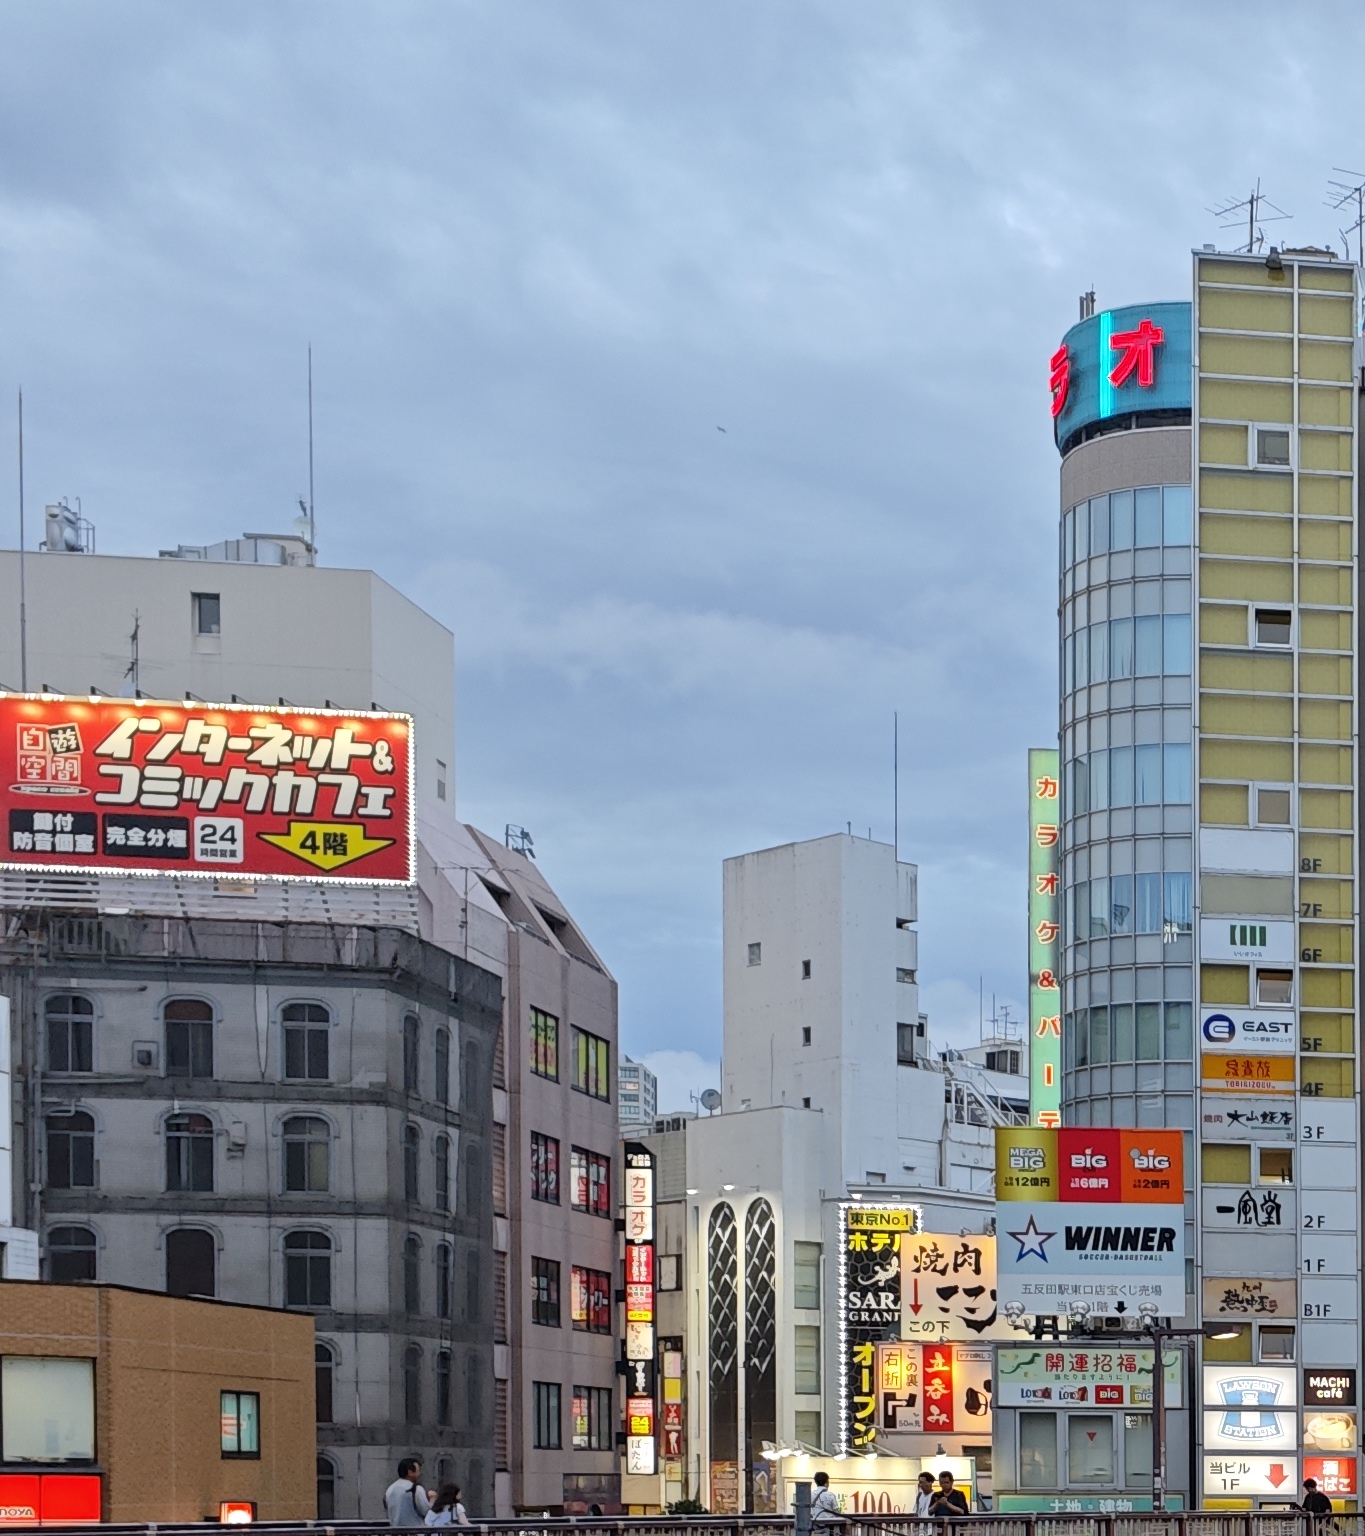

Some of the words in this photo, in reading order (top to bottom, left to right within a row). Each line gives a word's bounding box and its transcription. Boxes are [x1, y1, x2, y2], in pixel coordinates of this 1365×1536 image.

[95, 718, 394, 773] インターネット&
[95, 764, 394, 817] コミックカフェ
[200, 824, 237, 844] 24
[299, 830, 348, 856] 4階
[1301, 857, 1322, 873] 8F
[1301, 903, 1322, 918] 7F
[1301, 948, 1323, 963] 6F
[1242, 1021, 1294, 1034] EAST
[1302, 1037, 1323, 1051] 5F
[1302, 1082, 1325, 1097] 4F
[1302, 1125, 1326, 1140] 3F
[1010, 1148, 1045, 1156] MEGA
[1010, 1157, 1045, 1170] BIG
[1070, 1154, 1108, 1169] BIG
[1134, 1154, 1171, 1170] BIG
[631, 1175, 646, 1237] カラオケ
[1215, 1189, 1282, 1227] 一風堂
[850, 1213, 910, 1227] 東京No.1
[1303, 1215, 1327, 1229] 2F
[1065, 1225, 1177, 1253] WINNER
[910, 1241, 983, 1276] 焼肉
[1303, 1258, 1327, 1273] 1F
[1021, 1284, 1163, 1297] 五反田駅東口店宝くじ売場
[848, 1291, 901, 1310] SAR
[1303, 1303, 1332, 1318] B1F
[909, 1320, 950, 1333] この下
[883, 1351, 900, 1387] 右折
[1045, 1353, 1138, 1373] 開運招福
[1222, 1380, 1278, 1393] LAWSON
[1309, 1376, 1350, 1389] MACHI
[852, 1342, 877, 1447] オープン
[1315, 1387, 1344, 1400] café
[1224, 1424, 1279, 1437] STATION
[1209, 1461, 1251, 1476] 当ビル
[1221, 1478, 1240, 1491] 1F
